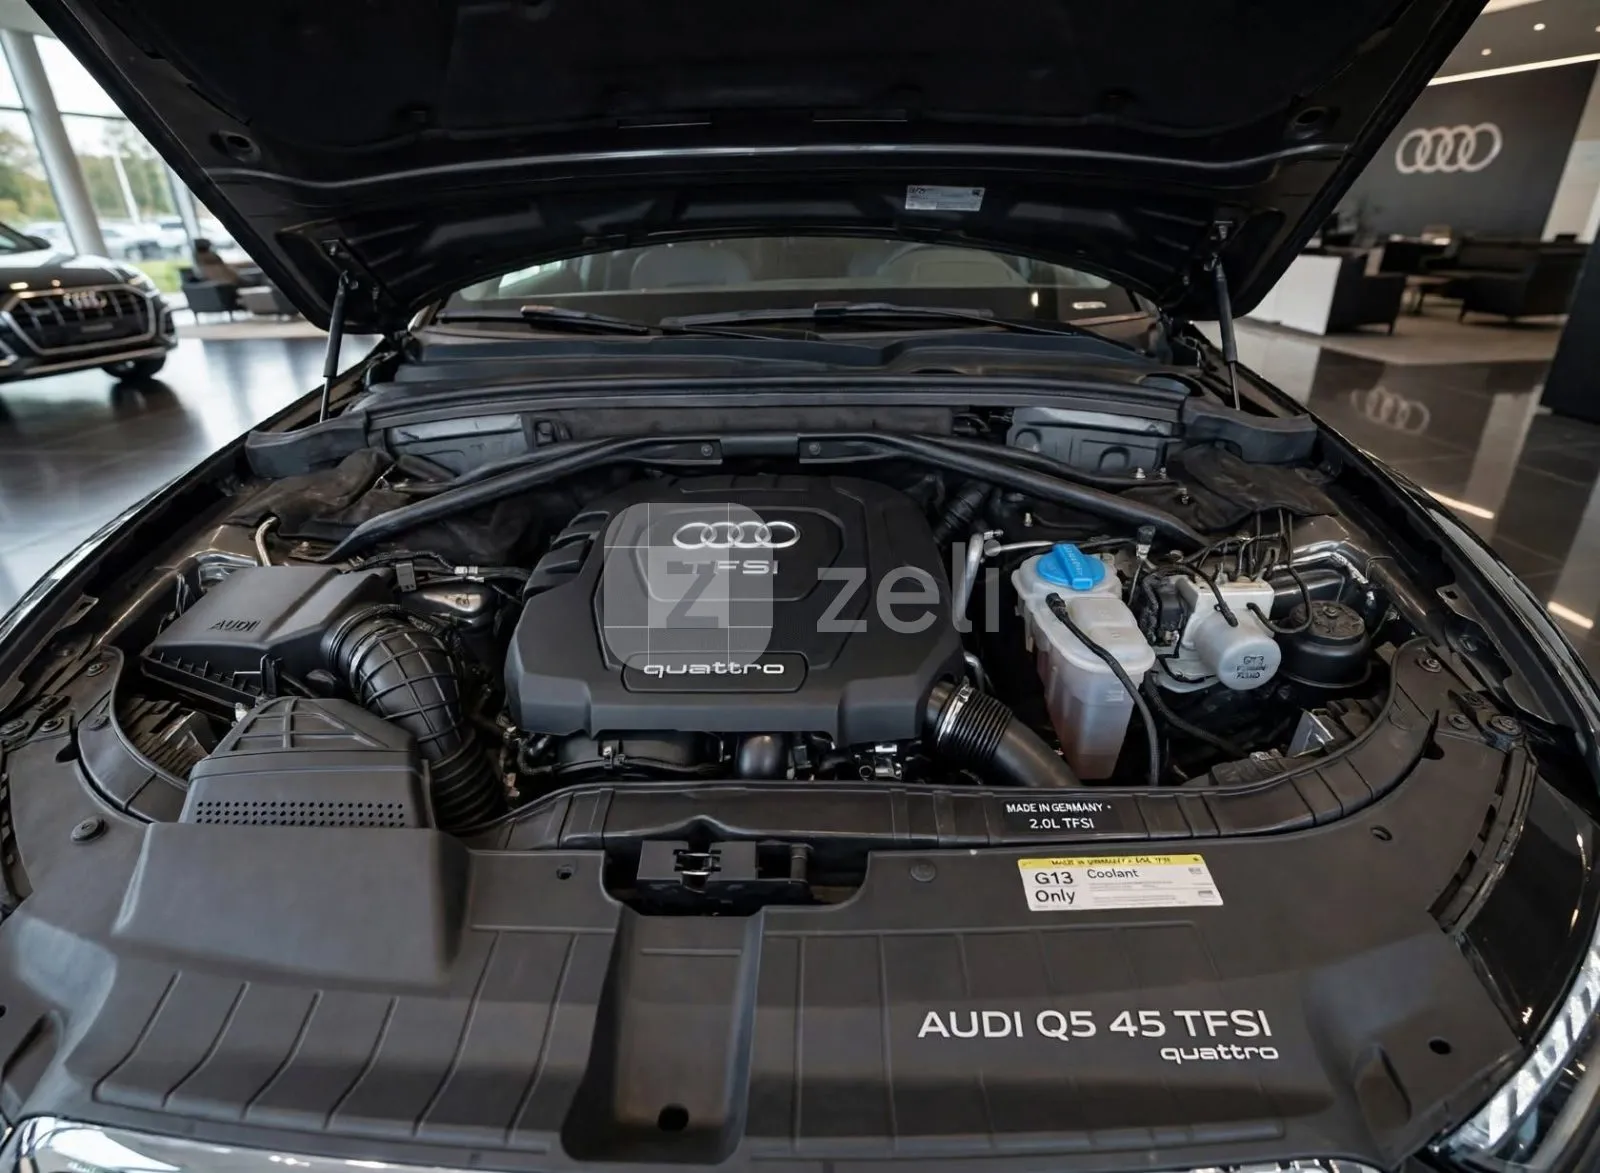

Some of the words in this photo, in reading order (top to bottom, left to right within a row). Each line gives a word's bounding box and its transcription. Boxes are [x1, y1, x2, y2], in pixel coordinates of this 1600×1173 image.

[682, 559, 779, 575] TFSI
[208, 618, 262, 632] AUDI
[642, 661, 786, 679] quattro
[1006, 803, 1038, 813] MADE
[1039, 803, 1050, 812] IN
[1051, 802, 1103, 813] GERMANY
[1029, 818, 1061, 829] 2.0L
[1062, 817, 1095, 829] TFSI
[1035, 871, 1074, 885] G13
[1086, 868, 1139, 879] Coolant
[1035, 887, 1076, 905] Only
[917, 1010, 1024, 1038] AUDI
[1036, 1009, 1097, 1041] Q5
[1109, 1010, 1166, 1038] 45
[1173, 1009, 1273, 1037] TFSI
[1160, 1043, 1279, 1065] quattro
